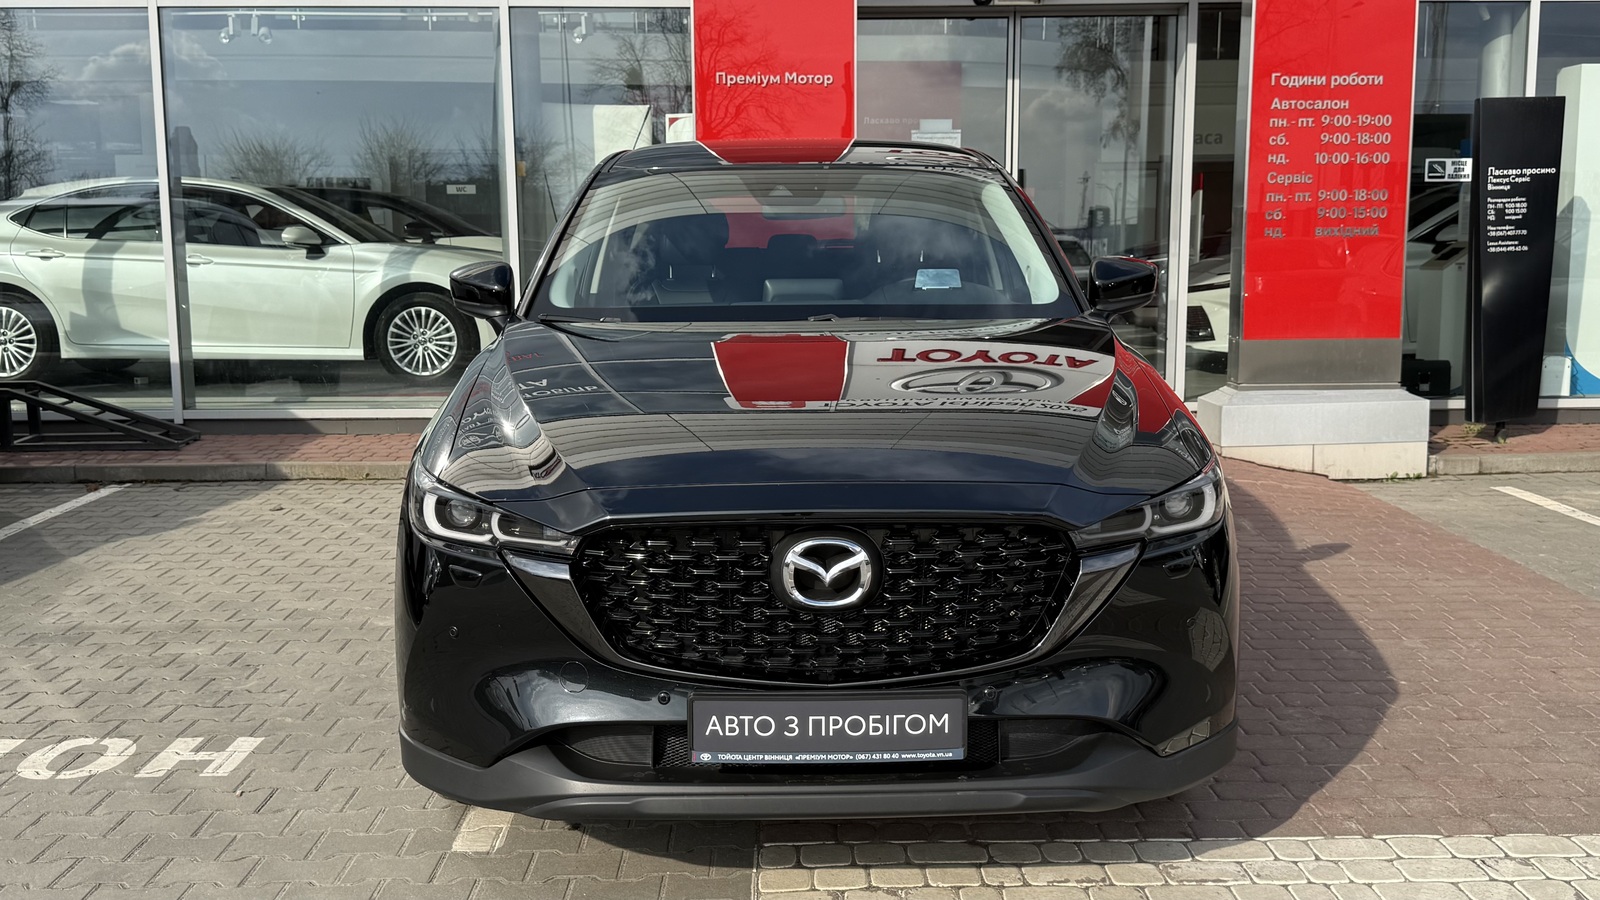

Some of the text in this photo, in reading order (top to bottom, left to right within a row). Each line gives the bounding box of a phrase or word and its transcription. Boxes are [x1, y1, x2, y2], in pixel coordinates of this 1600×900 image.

[715, 71, 834, 88] Преміум Мотор
[1270, 71, 1384, 89] Години роботи
[1270, 97, 1350, 110] Автосалон
[1320, 114, 1393, 127] 9:00-19:00
[1194, 132, 1224, 145] аса
[1268, 132, 1392, 146] сб. 9:00-18:00
[1267, 151, 1391, 165] нд. 10:00-16:00
[1488, 166, 1557, 176] Ласкаво просимо
[1266, 170, 1313, 187] Сервіс
[1488, 175, 1531, 184] Лексус Сервіс
[1487, 183, 1511, 191] Вінниця
[1317, 188, 1389, 202] 9:00-18:00
[1264, 206, 1388, 221] сб. 9:00-15:00
[1264, 223, 1380, 239] нд. вихідний
[705, 715, 776, 737] АВТО
[808, 713, 950, 737] ПРОБІГОМ
[717, 753, 742, 761] ТОЙОТА
[743, 754, 763, 762] ЦЕНТР
[764, 754, 793, 762] ВІННИЦЯ
[855, 753, 871, 761] (067)
[901, 751, 953, 760] www.toyota.vn.ua
